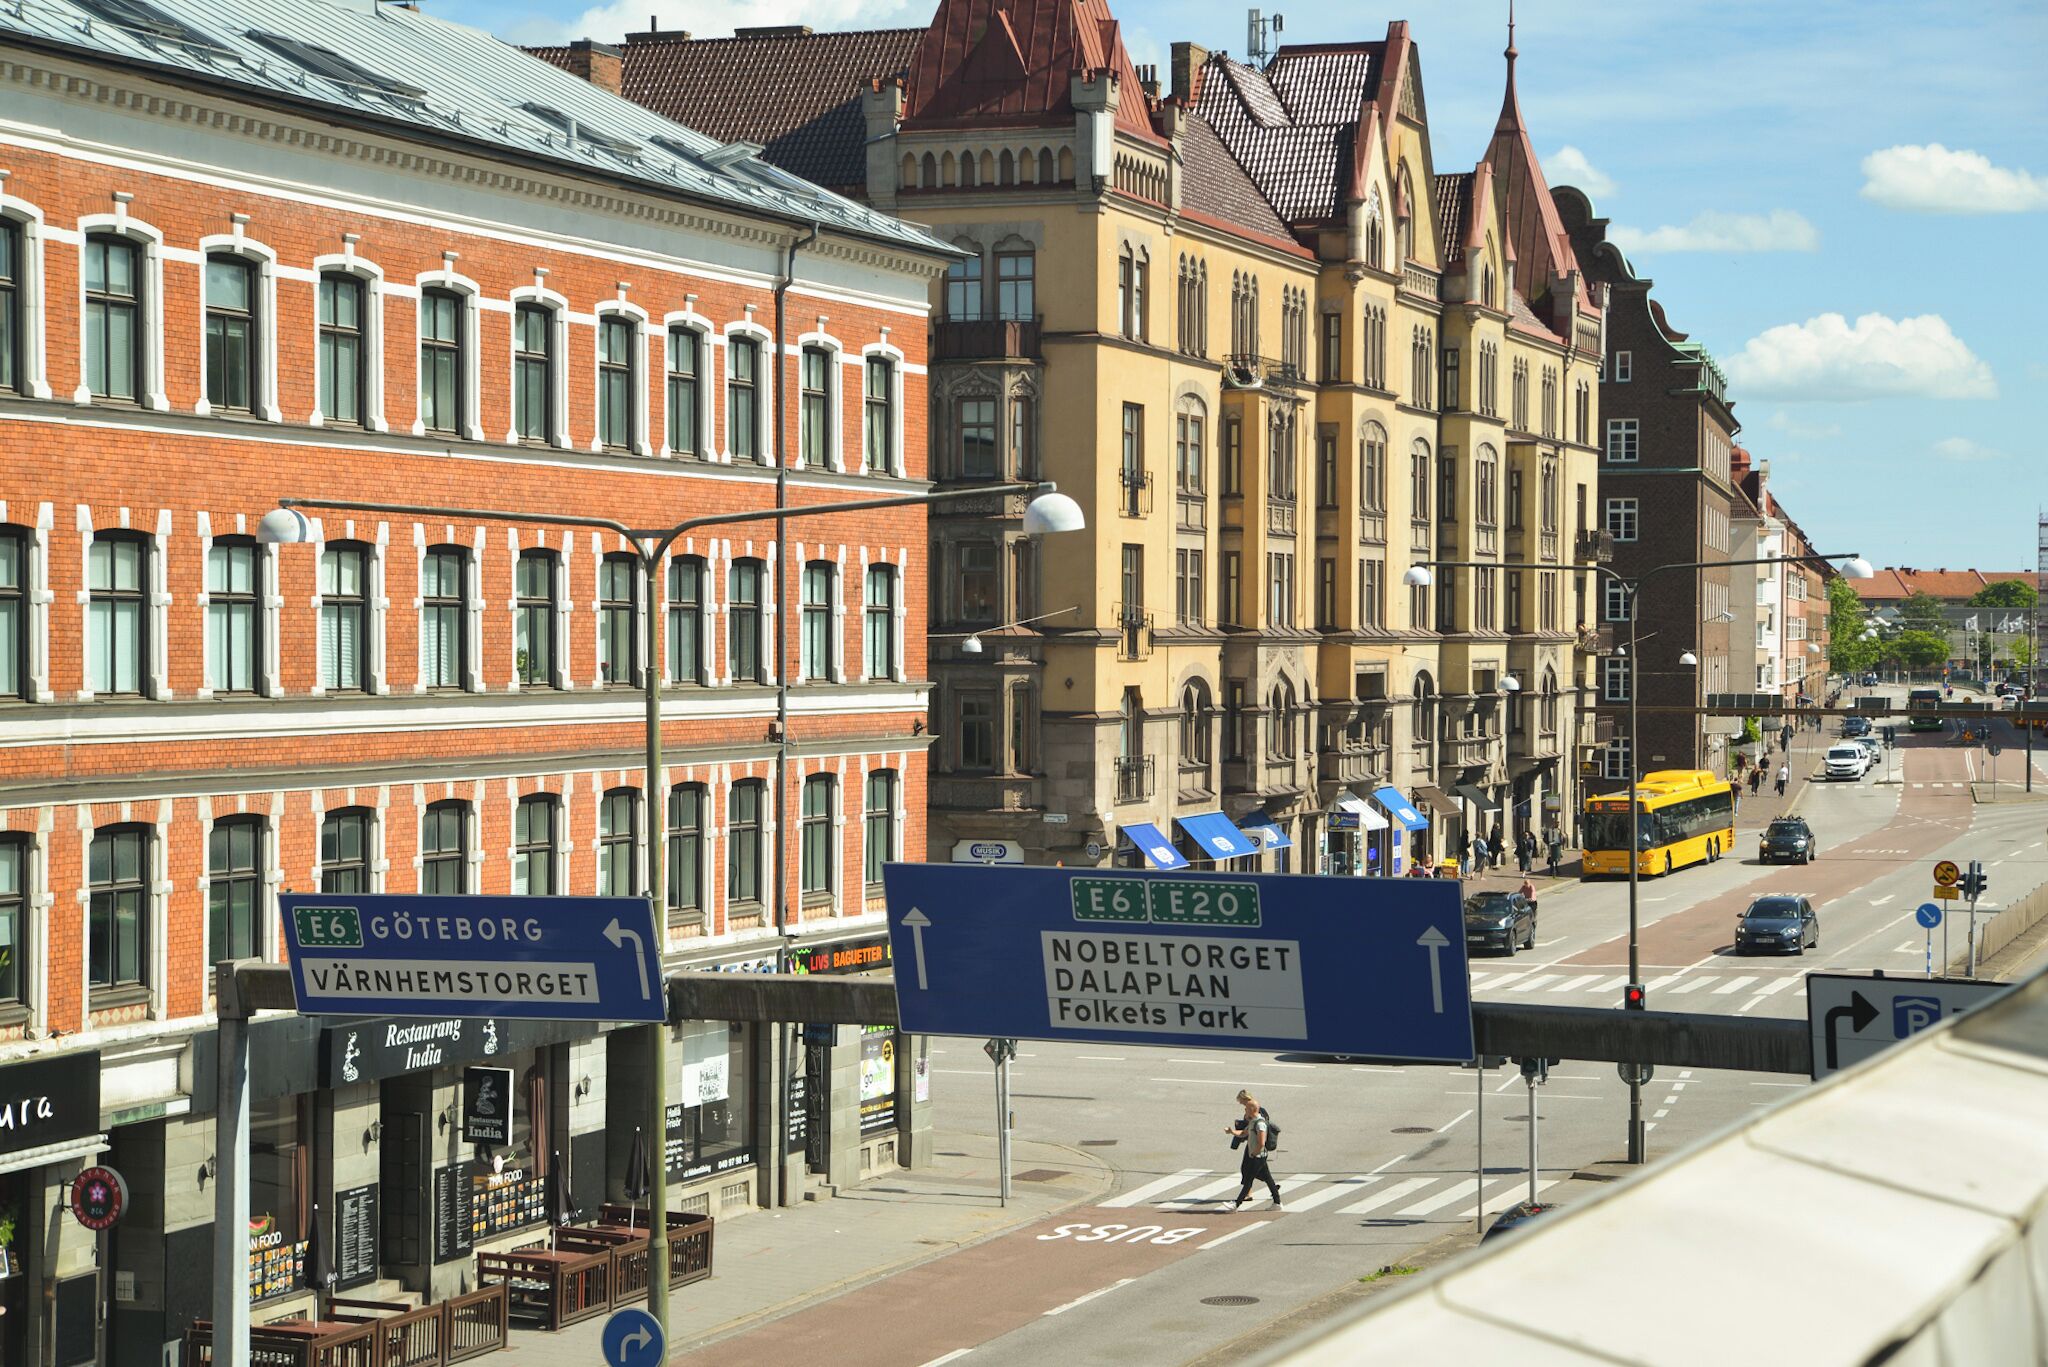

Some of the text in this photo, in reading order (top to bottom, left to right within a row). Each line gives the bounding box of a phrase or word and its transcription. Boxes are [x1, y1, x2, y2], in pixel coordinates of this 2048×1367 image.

[976, 847, 1001, 856] MUSIK
[1089, 887, 1239, 916] E6 E20
[311, 911, 543, 941] E6 GÖTEBORG
[810, 954, 829, 972] LIVS
[833, 945, 883, 969] BAGUETTER
[1052, 938, 1290, 971] NOBELTORGET
[311, 963, 588, 997] VÄRNHEMSTORGET
[1055, 968, 1231, 999] DALAPLAN
[1059, 998, 1249, 1030] Folkets Park
[385, 1019, 462, 1048] Restaurang
[405, 1043, 442, 1070] India
[468, 1115, 503, 1126] Restaurang
[468, 1126, 503, 1140] India
[666, 1116, 682, 1129] Frisör
[504, 1168, 523, 1184] FOOD
[717, 1160, 728, 1170] 040
[259, 1231, 282, 1249] FOOD
[1036, 1223, 1208, 1245] BUSS
